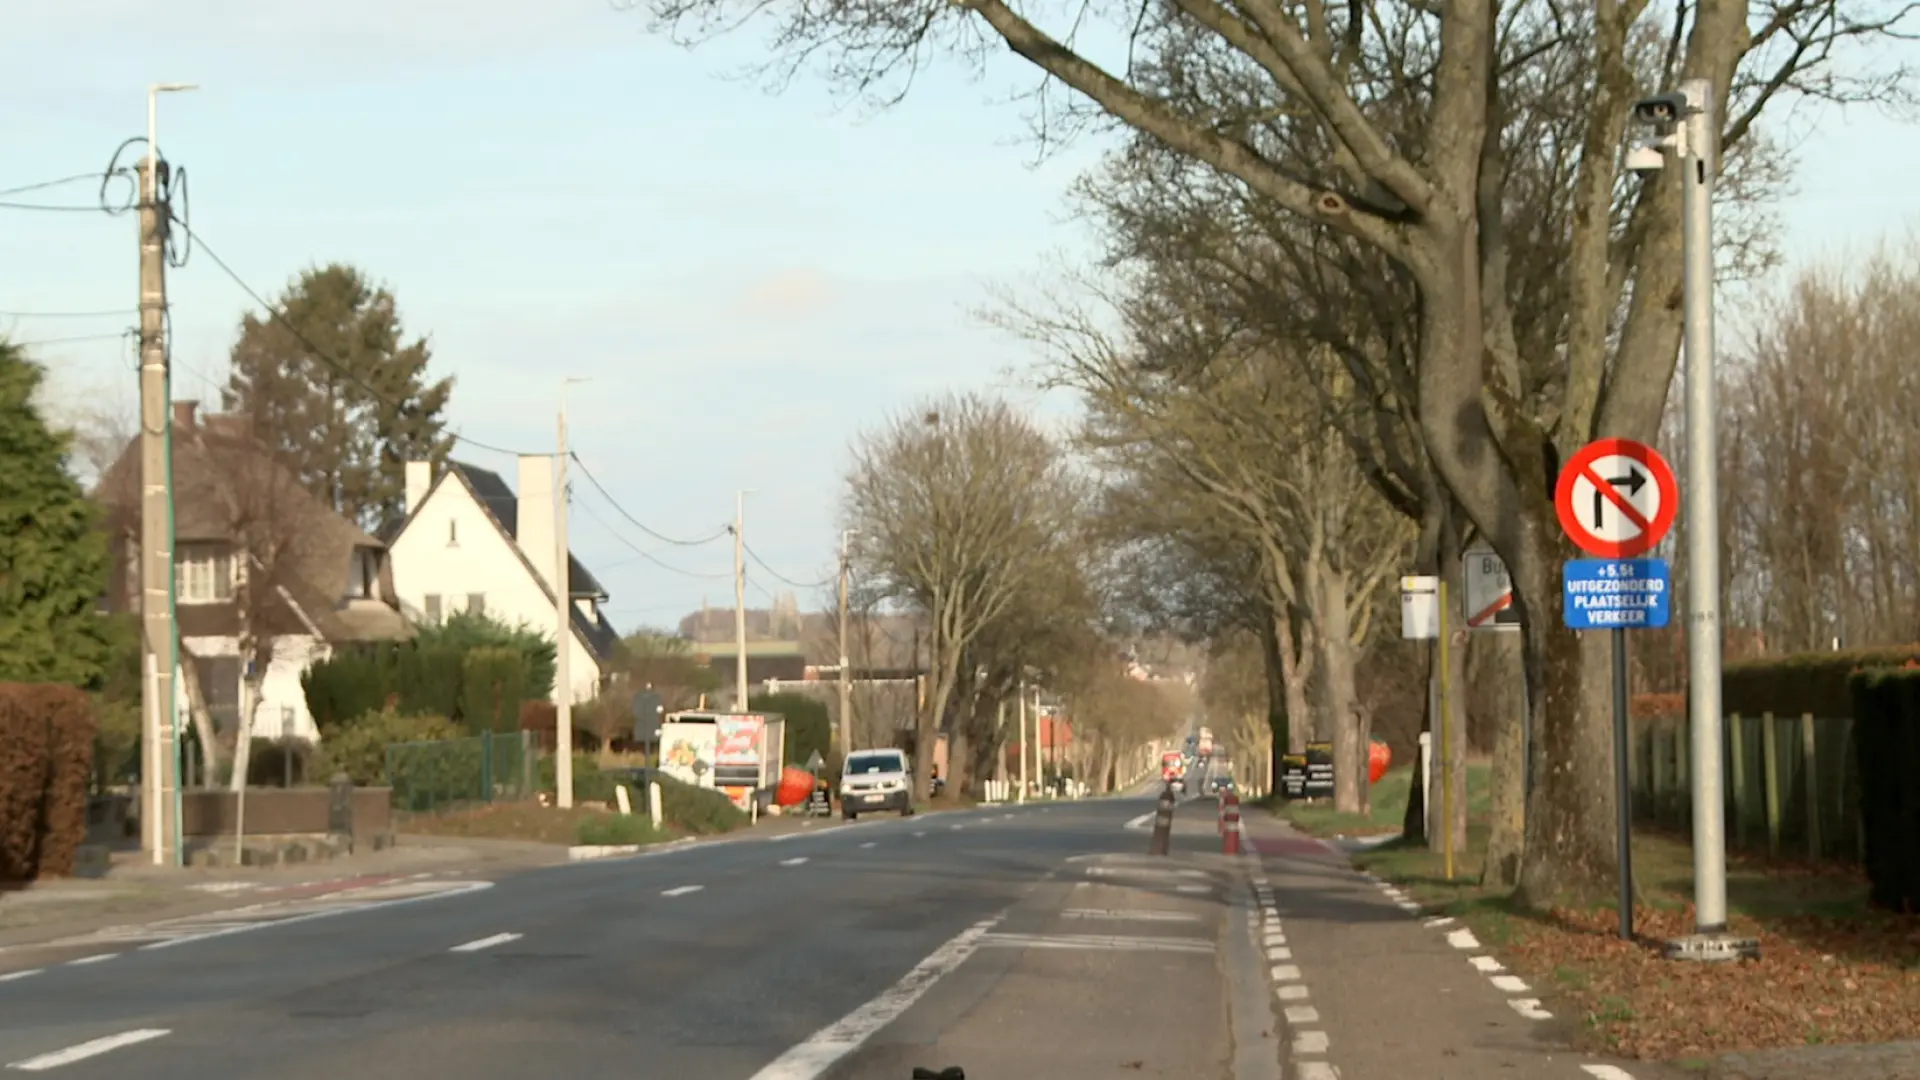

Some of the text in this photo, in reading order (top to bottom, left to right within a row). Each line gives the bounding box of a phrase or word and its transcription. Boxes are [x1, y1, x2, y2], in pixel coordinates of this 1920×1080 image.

[1567, 579, 1664, 593] UITGEZONDERD
[1574, 595, 1658, 609] PLAATSELIJK
[1587, 610, 1645, 624] VERKEER
